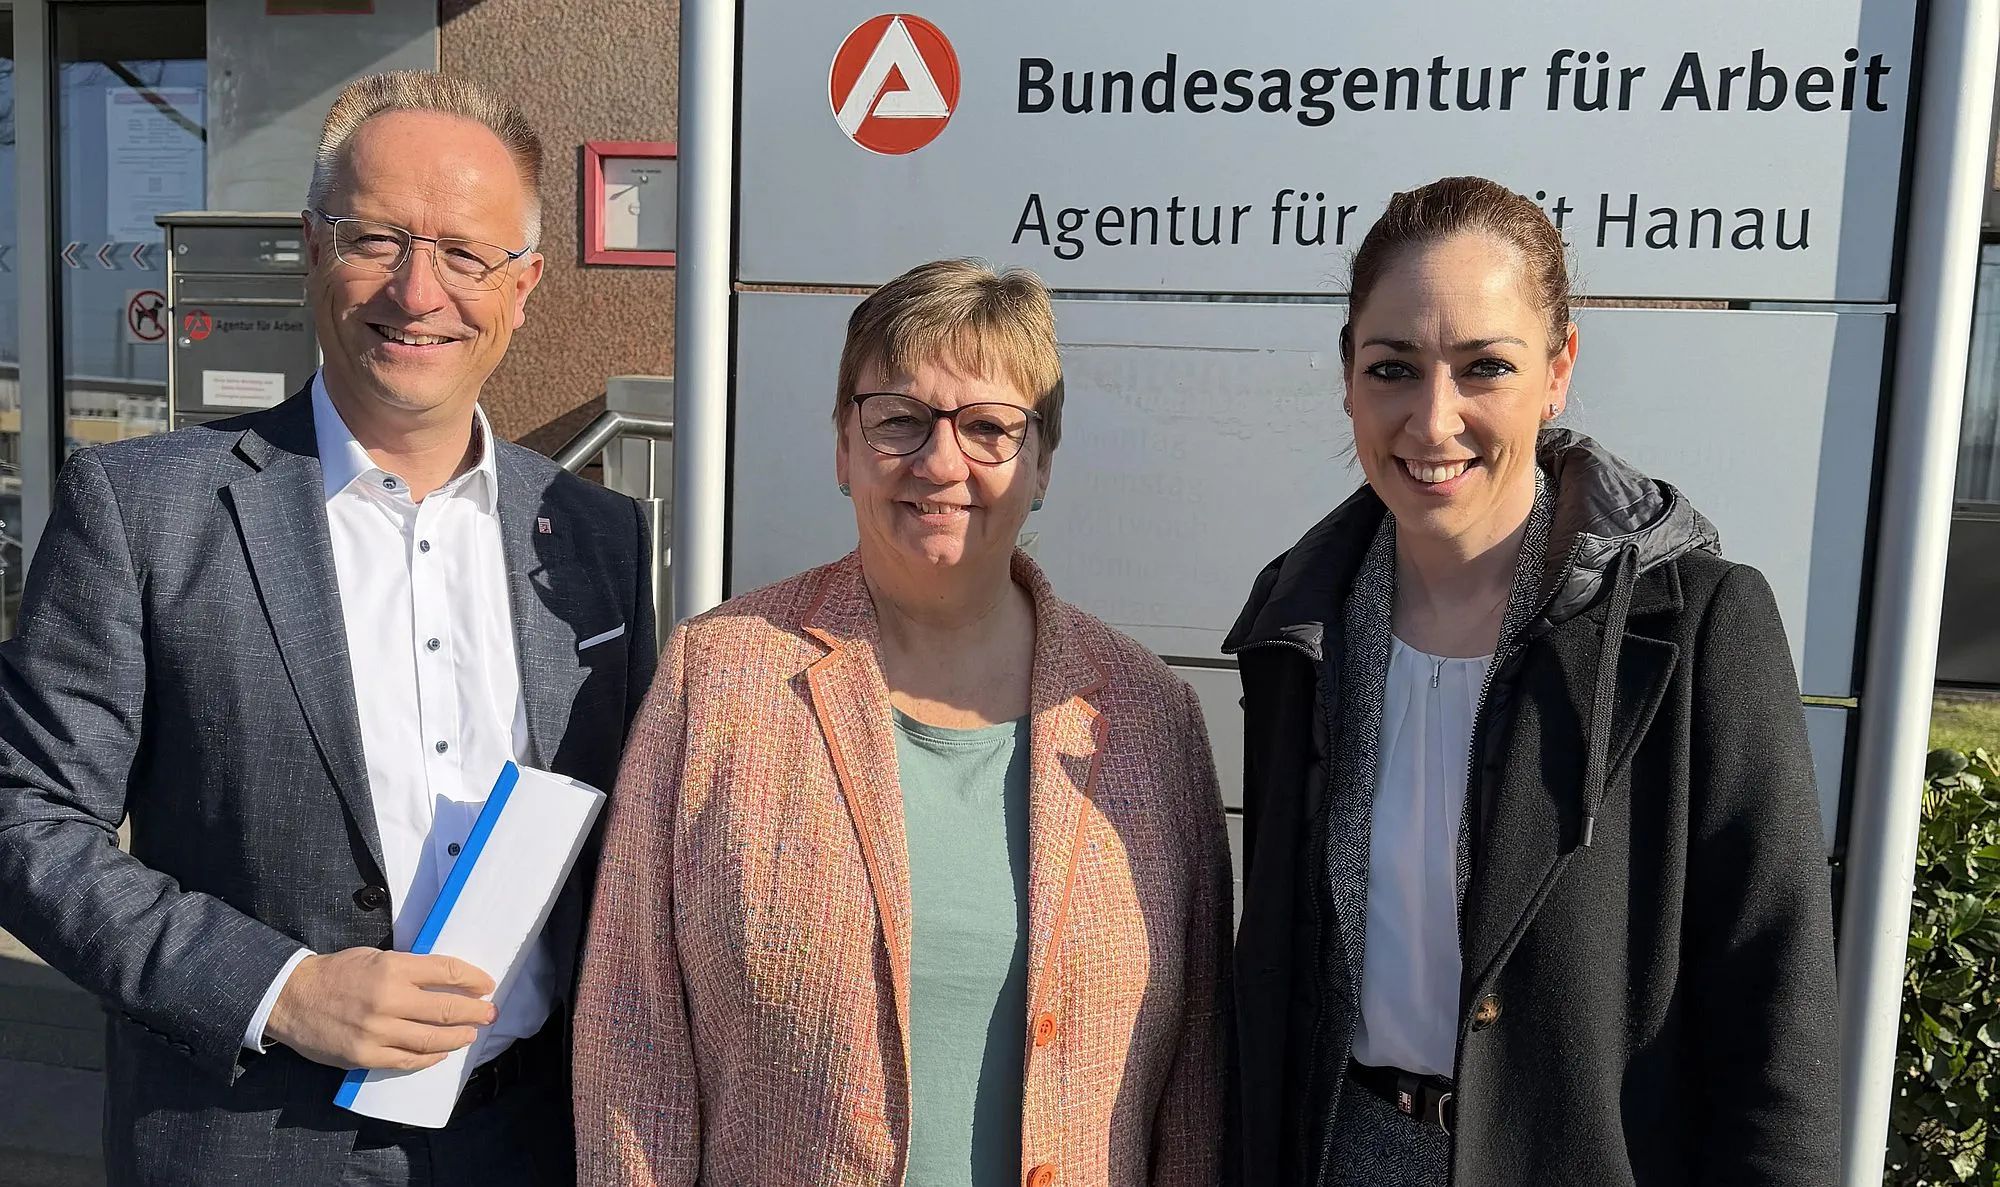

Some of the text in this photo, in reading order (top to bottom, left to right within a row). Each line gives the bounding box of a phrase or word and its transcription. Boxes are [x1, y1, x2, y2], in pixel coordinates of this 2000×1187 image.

[1018, 48, 1891, 126] Bundesagentur für Arbeit
[1012, 194, 1252, 260] Agentur
[1272, 189, 1357, 245] für
[1597, 194, 1809, 250] Hanau
[215, 320, 304, 333] Agentur für Arbeit
